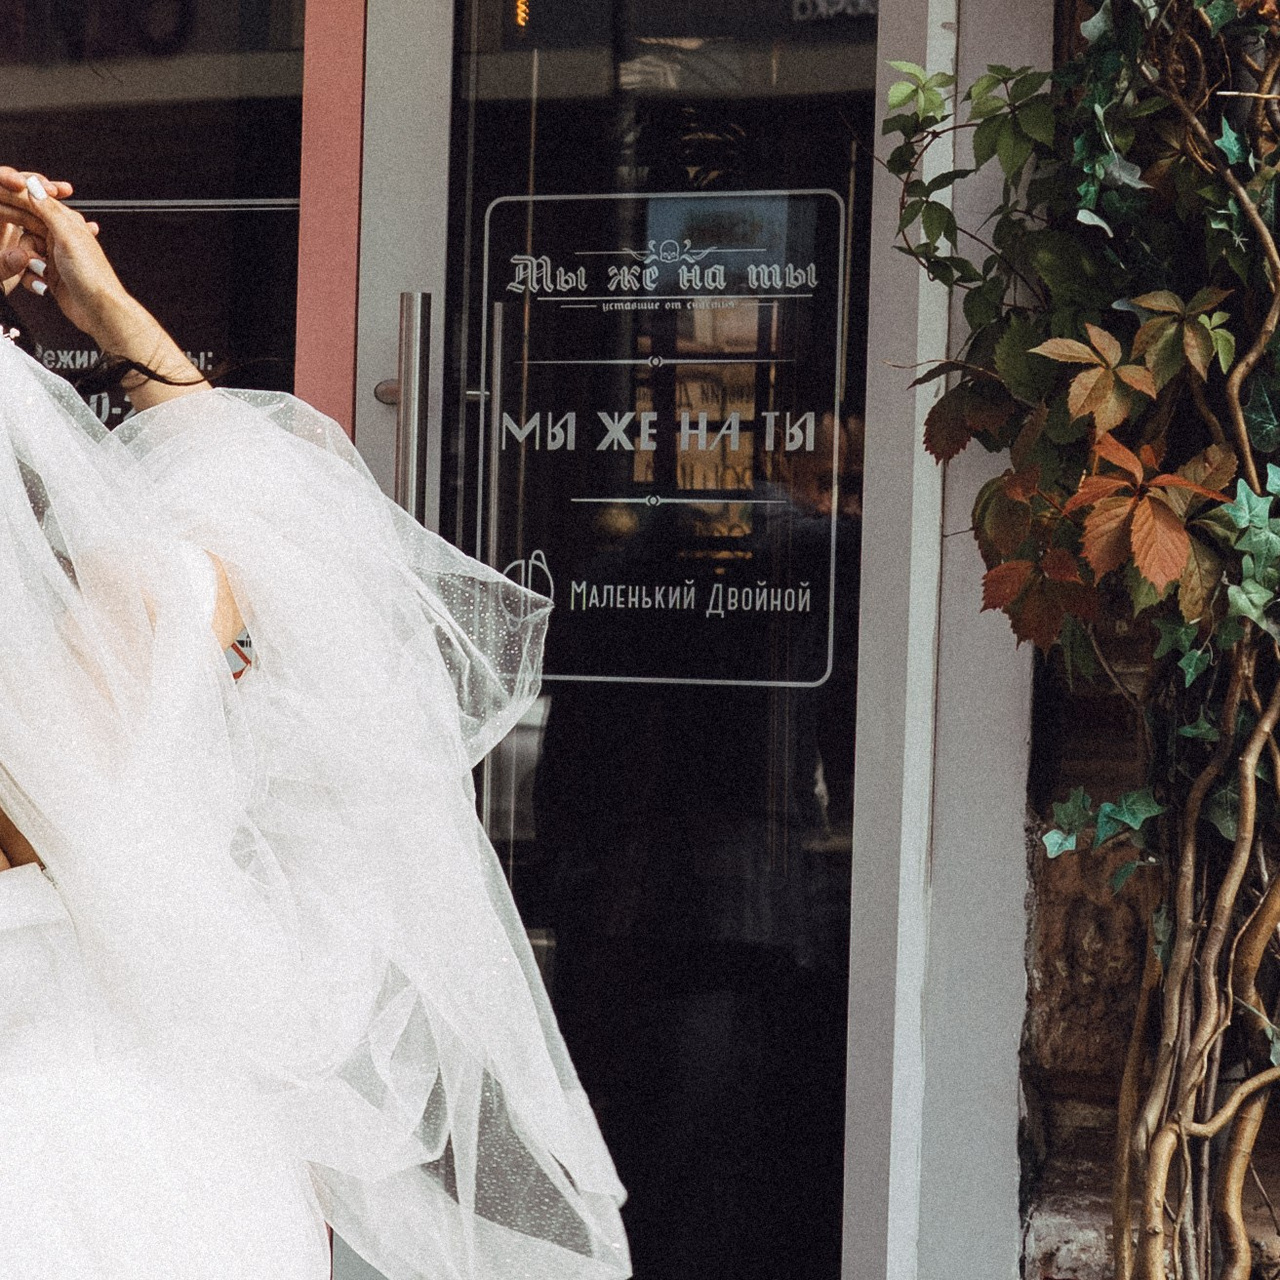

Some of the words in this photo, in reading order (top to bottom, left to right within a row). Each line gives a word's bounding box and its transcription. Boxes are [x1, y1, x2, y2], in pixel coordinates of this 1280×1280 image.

[506, 254, 589, 294] Мы
[607, 264, 659, 292] же
[678, 263, 728, 291] на
[664, 301, 682, 310] от
[501, 412, 576, 451] МЫ
[596, 412, 657, 451] ЖЕ
[680, 412, 740, 451] НА
[761, 411, 815, 452] ТЫ
